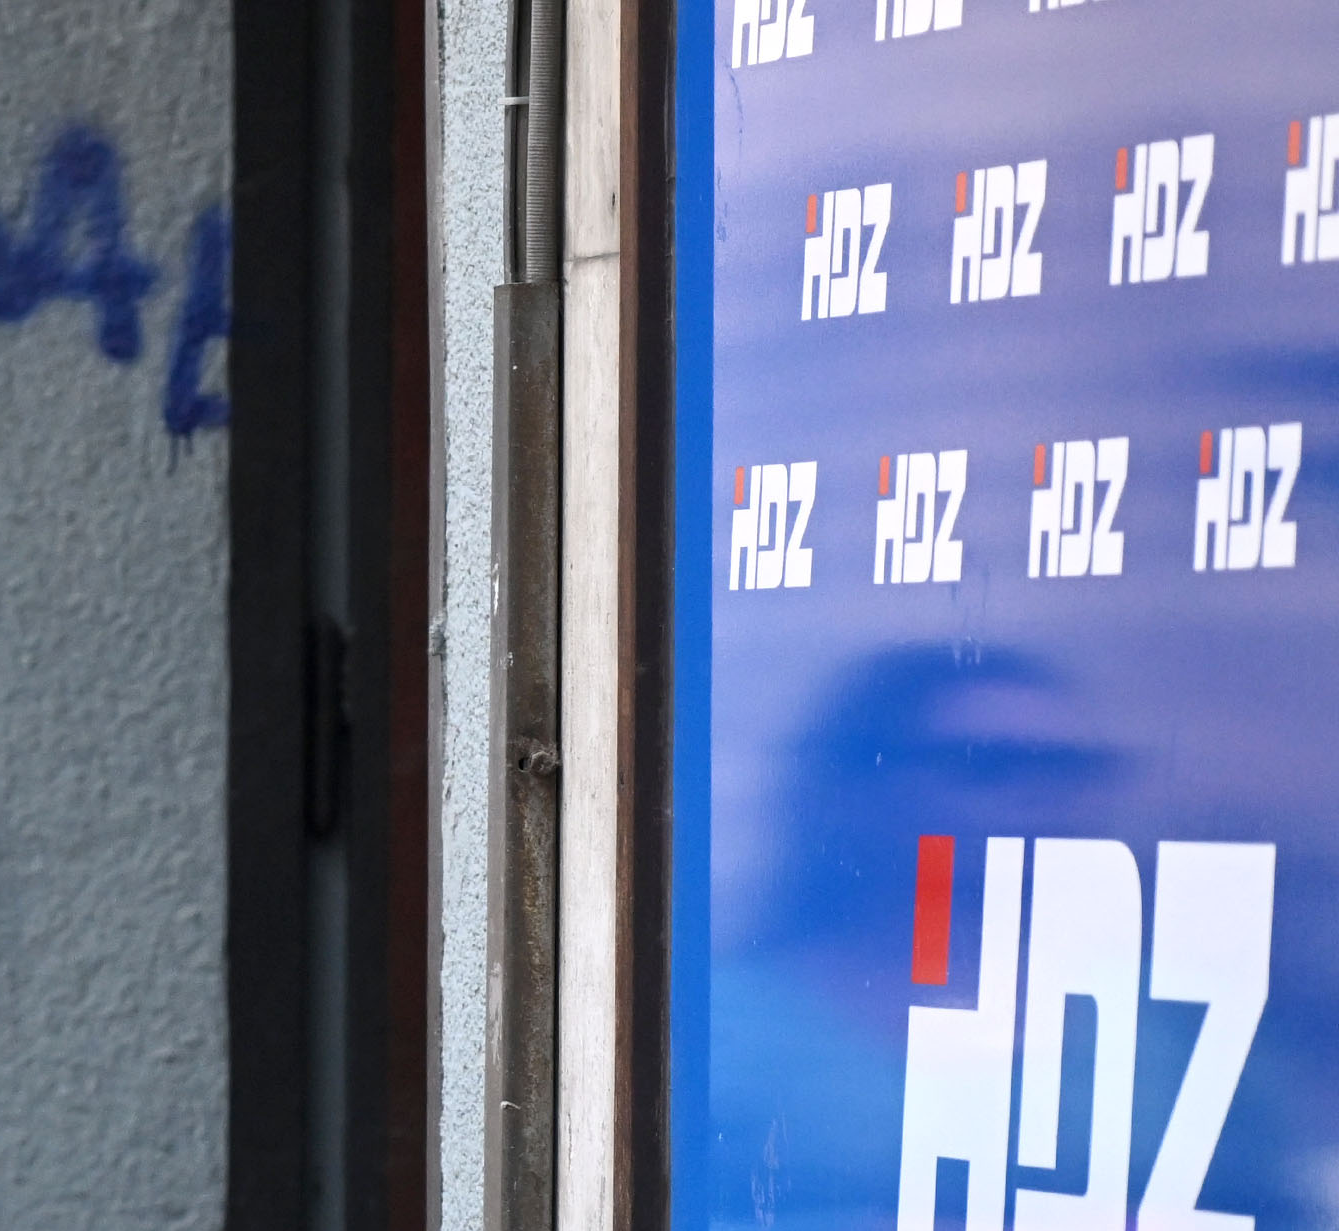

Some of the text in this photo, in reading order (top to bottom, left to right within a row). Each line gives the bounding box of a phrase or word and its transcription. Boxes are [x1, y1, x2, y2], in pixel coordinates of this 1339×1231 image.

[801, 183, 891, 320] HDZ
[950, 159, 1047, 303] HDZ
[1110, 134, 1215, 285] HDZ
[1281, 114, 1339, 265] HD
[730, 461, 817, 590] HDZ
[874, 449, 968, 584] HDZ
[1028, 437, 1129, 577] HDZ
[1194, 422, 1302, 571] HDZ
